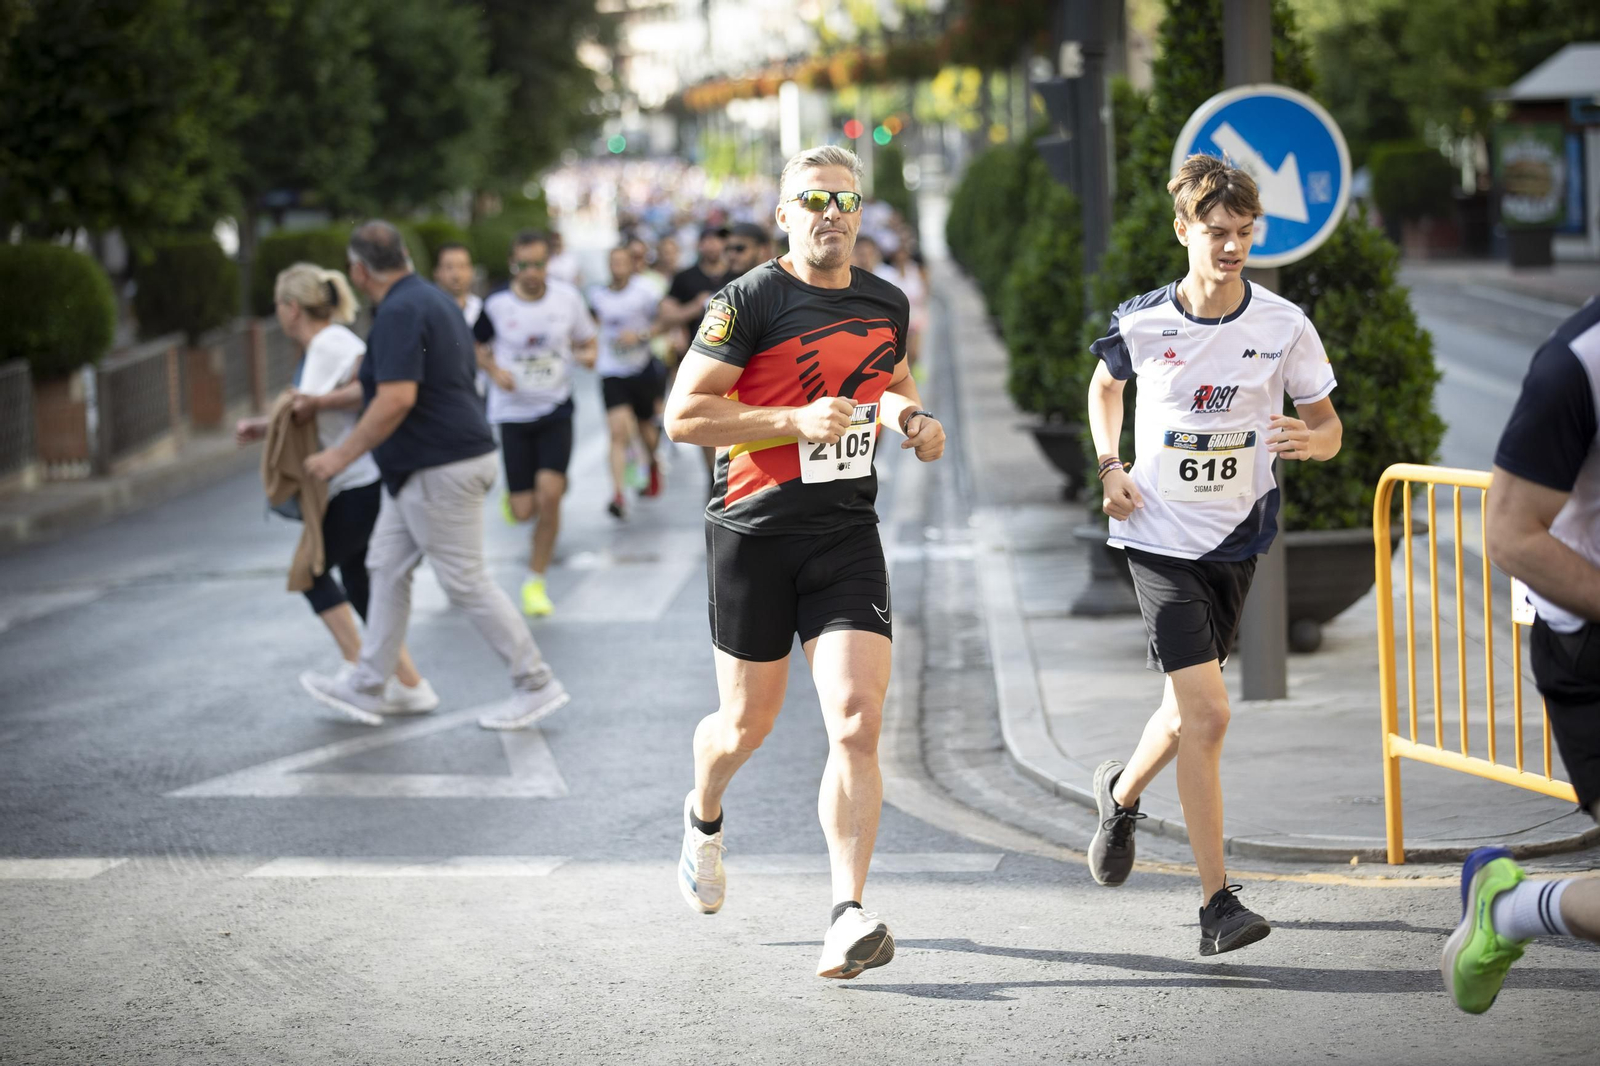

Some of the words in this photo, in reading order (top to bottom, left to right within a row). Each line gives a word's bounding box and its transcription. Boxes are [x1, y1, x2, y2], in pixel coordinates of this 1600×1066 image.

[808, 431, 871, 461] 2105
[1207, 432, 1248, 448] GRANADA
[1179, 456, 1238, 482] 618
[1194, 485, 1212, 493] SIGMA
[1213, 484, 1224, 492] BOY
